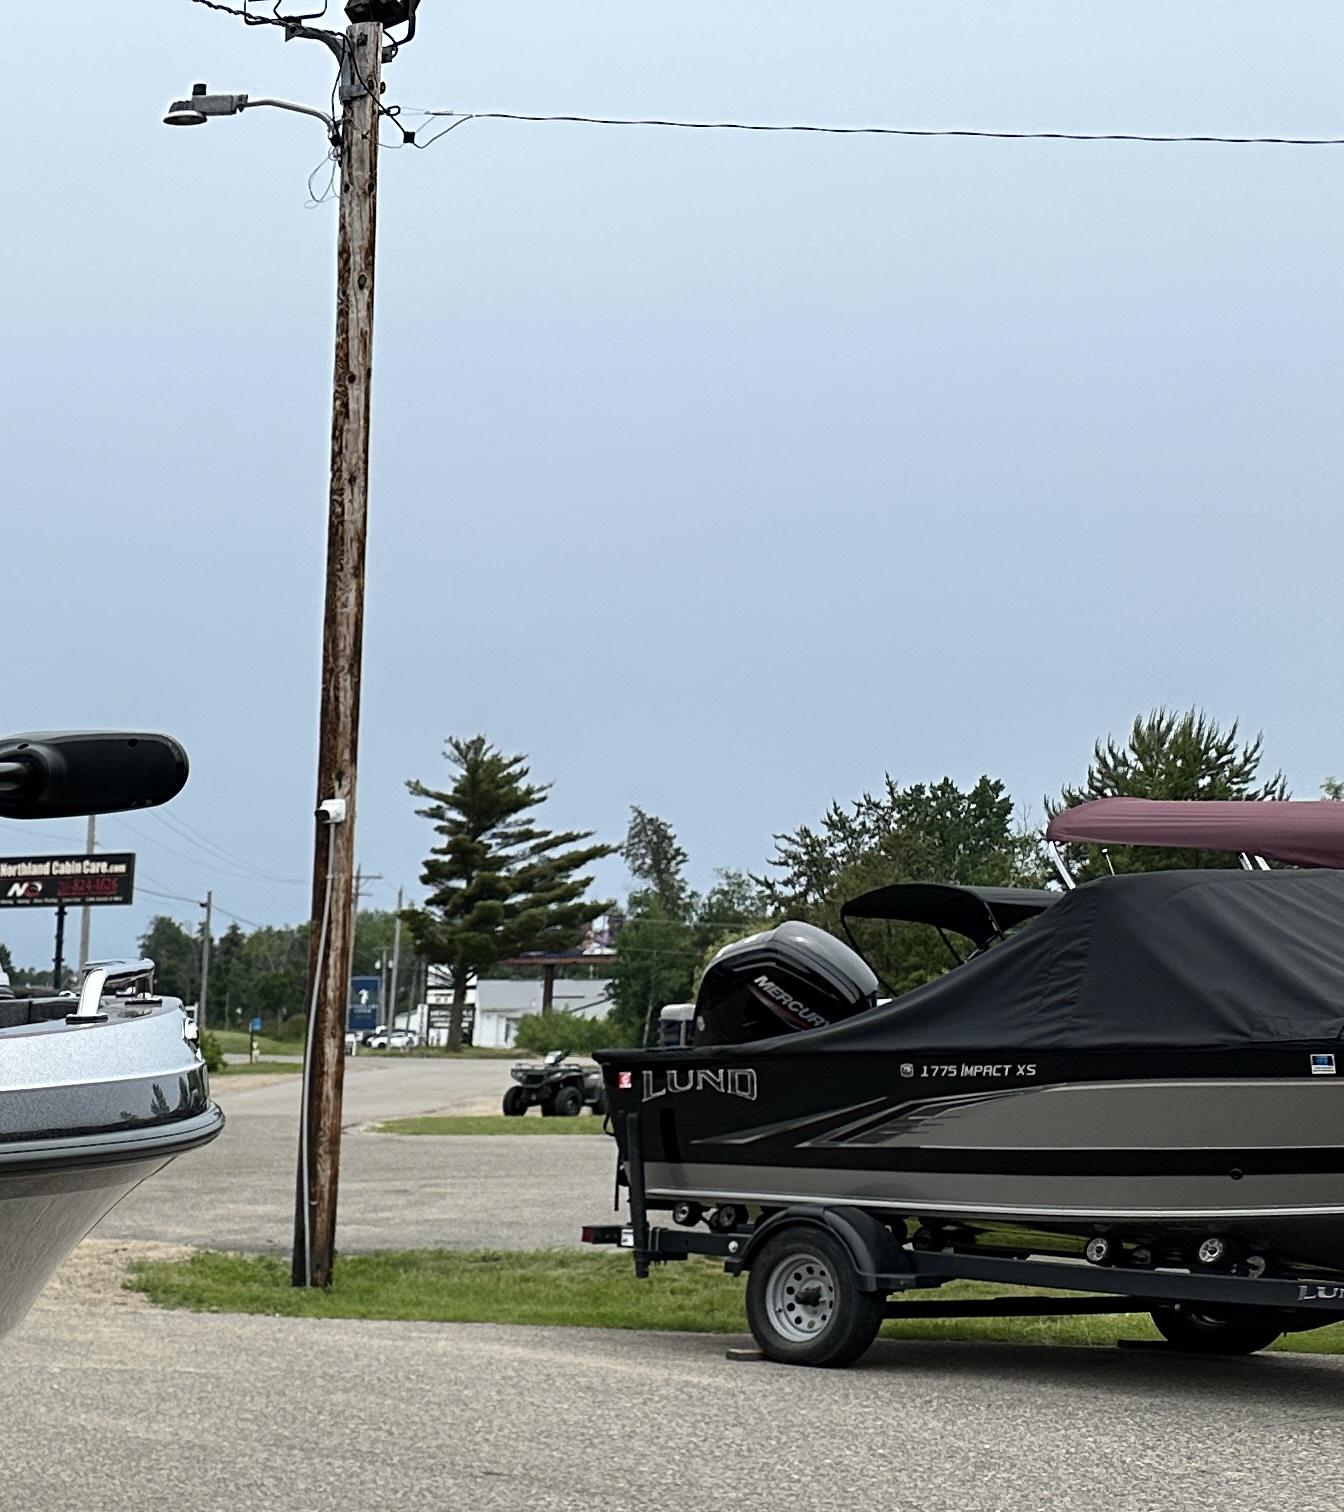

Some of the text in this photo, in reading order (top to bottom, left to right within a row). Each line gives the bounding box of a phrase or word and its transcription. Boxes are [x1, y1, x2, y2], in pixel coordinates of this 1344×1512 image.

[0, 861, 51, 877] Northland
[920, 1065, 958, 1077] 1775
[961, 1063, 1012, 1077] IMPACT
[1015, 1064, 1037, 1076] XS
[642, 1068, 758, 1102] LUND
